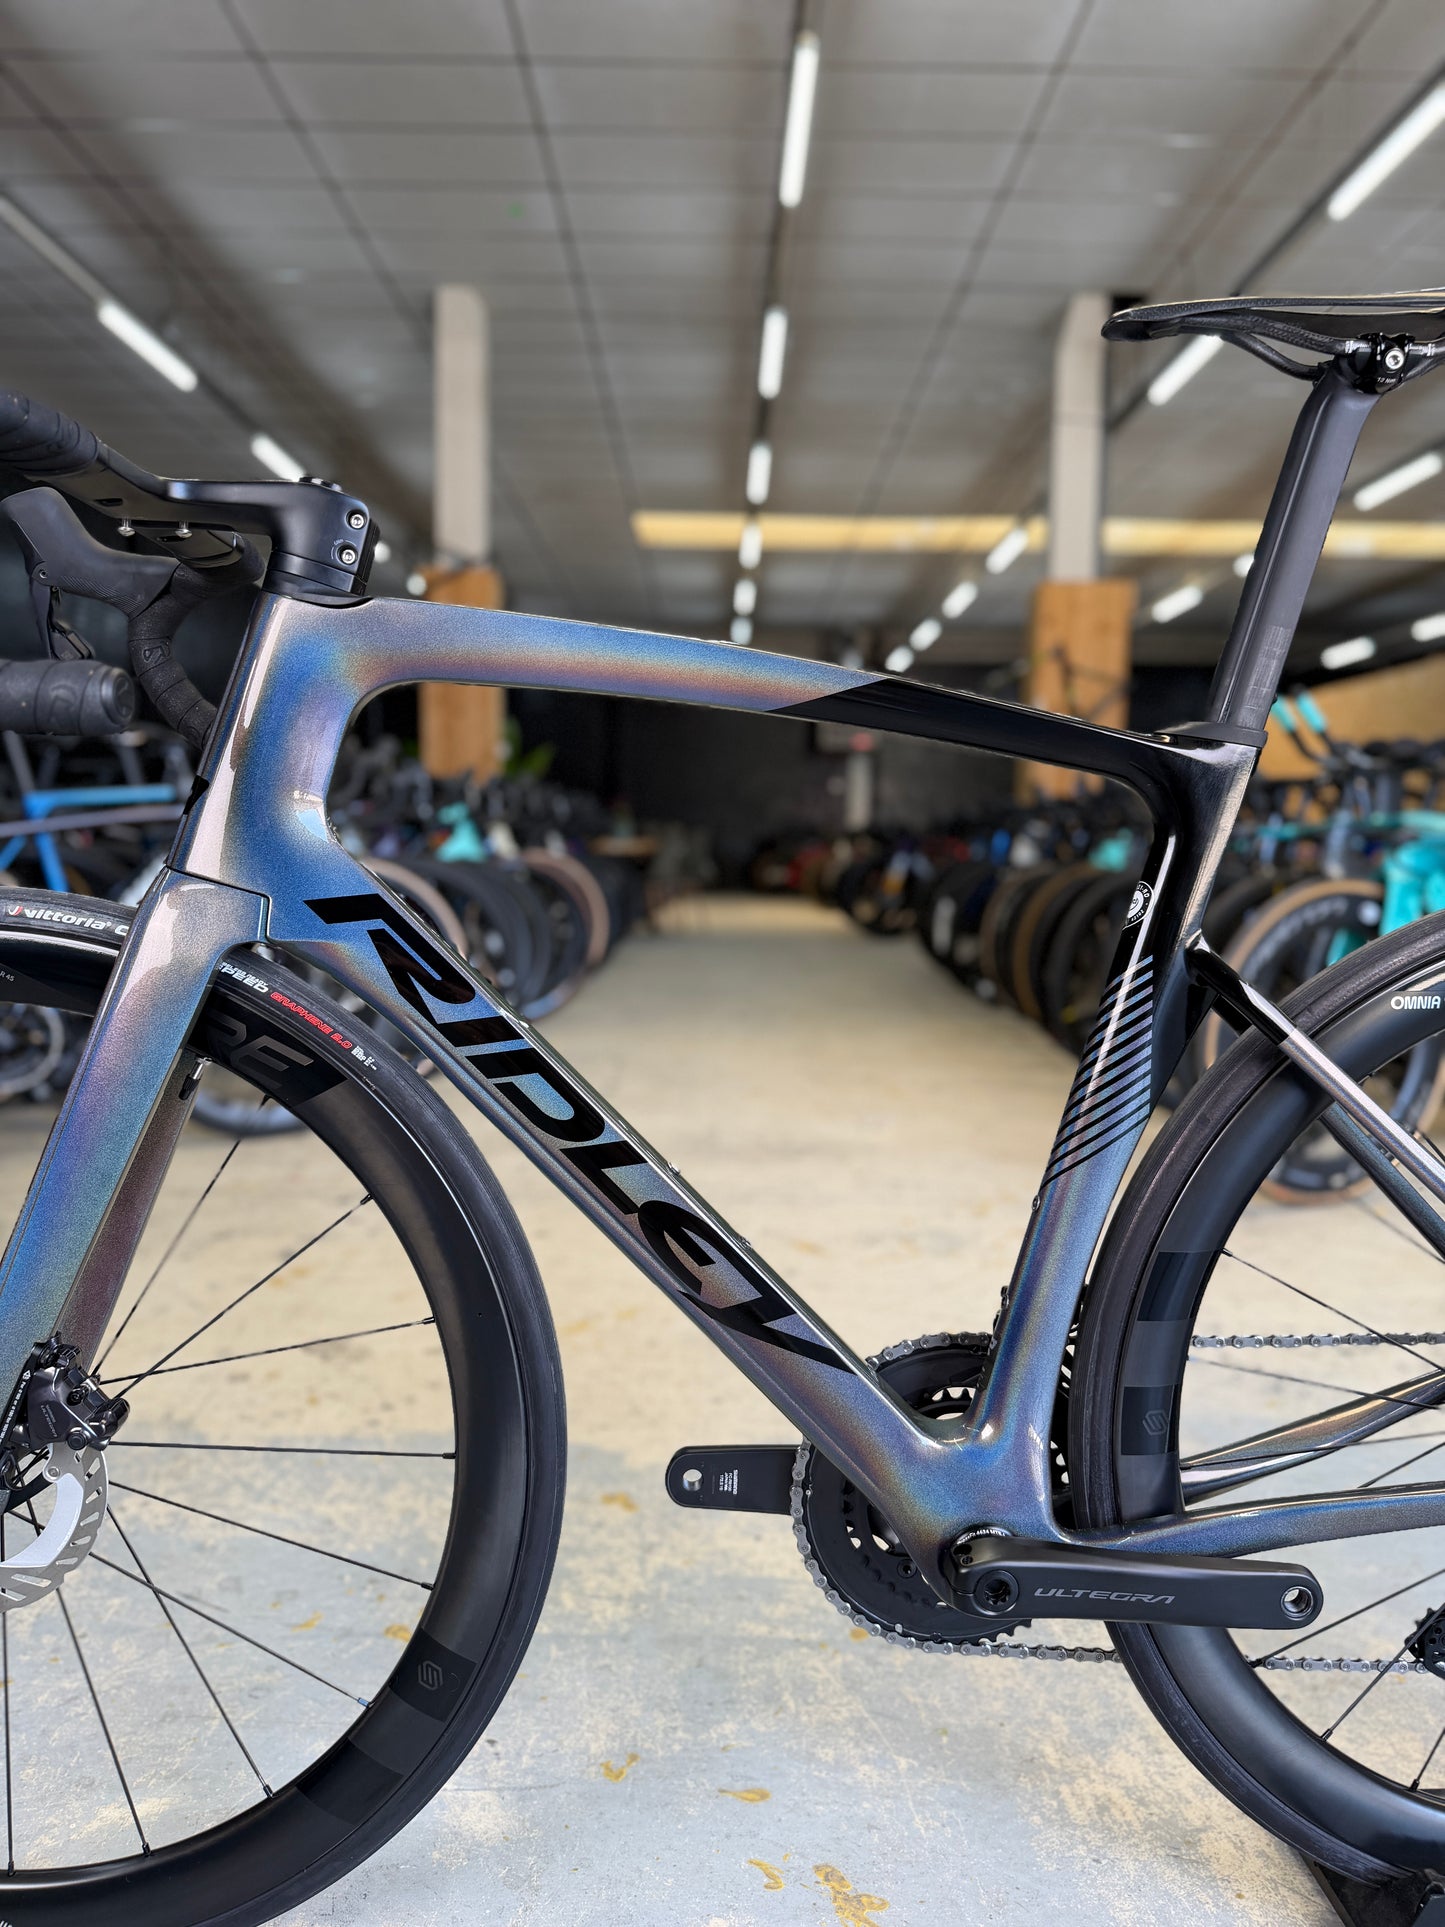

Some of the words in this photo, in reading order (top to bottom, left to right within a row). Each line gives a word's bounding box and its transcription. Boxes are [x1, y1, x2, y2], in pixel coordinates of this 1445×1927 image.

[270, 991, 334, 1036] GRAPHENE
[330, 1032, 353, 1050] 2.0
[1390, 995, 1442, 1010] OMNIA
[303, 893, 859, 1377] RIDLEY
[1034, 1587, 1177, 1604] ULTEGRA
